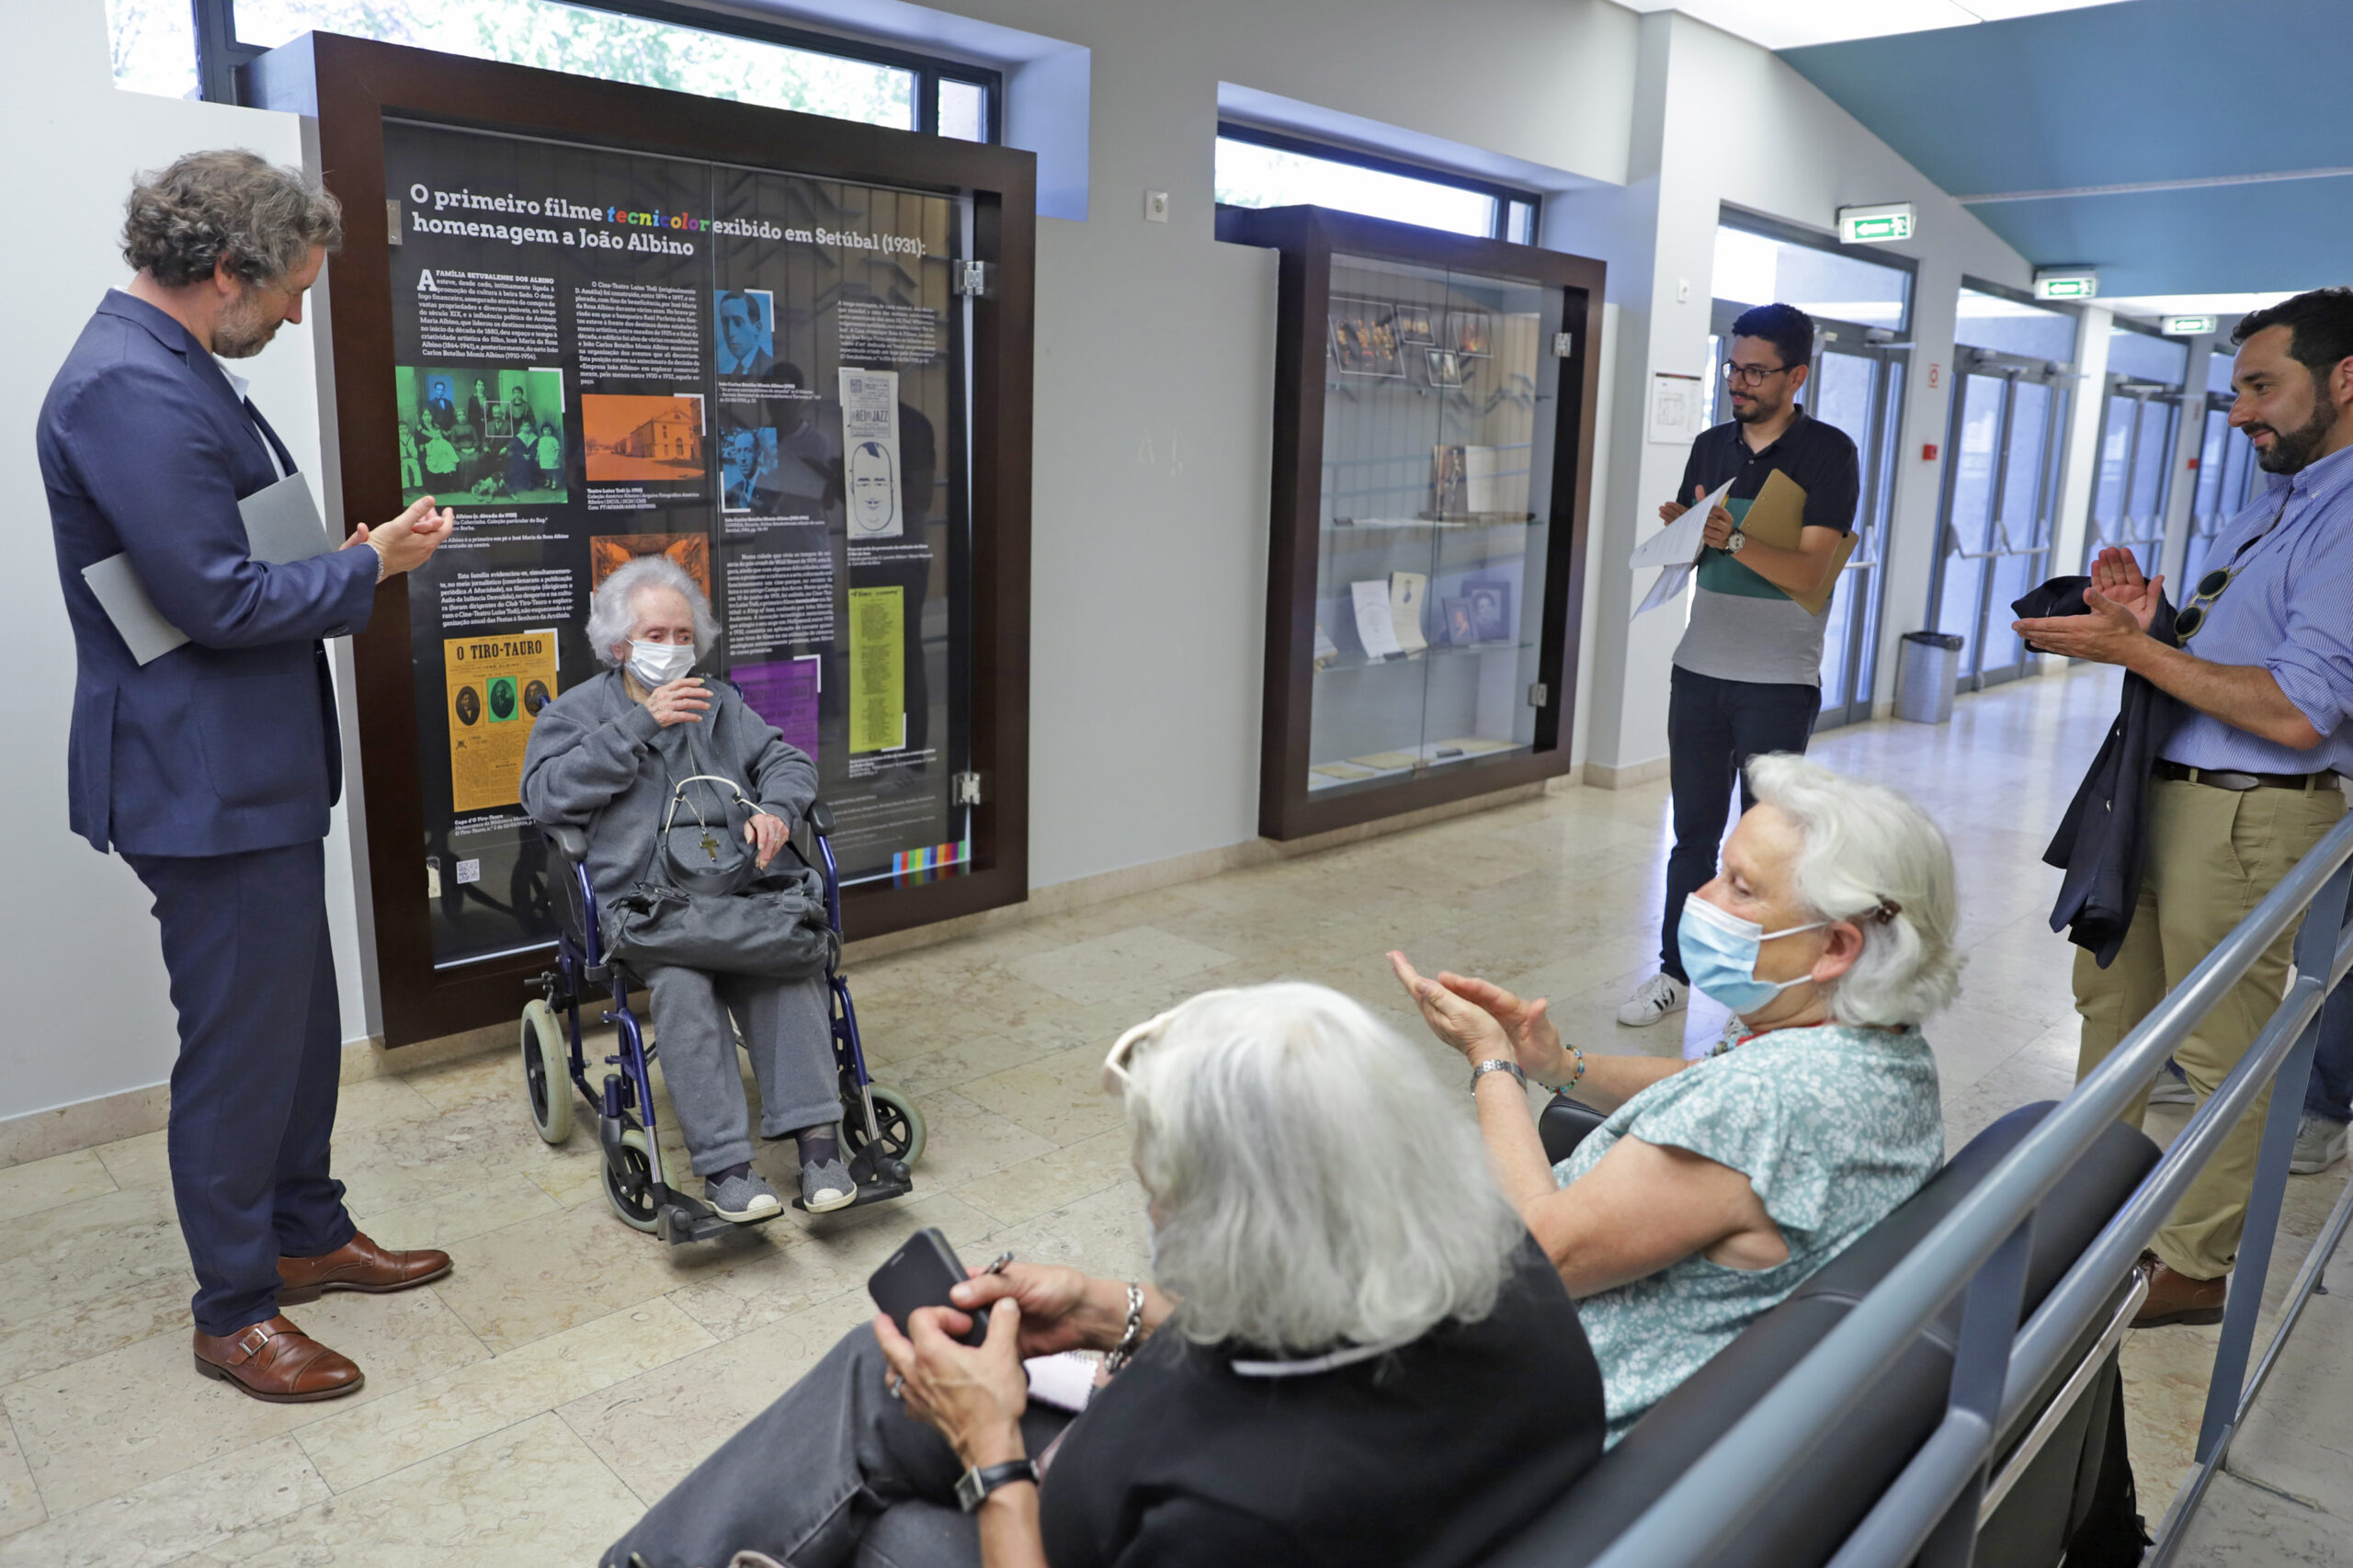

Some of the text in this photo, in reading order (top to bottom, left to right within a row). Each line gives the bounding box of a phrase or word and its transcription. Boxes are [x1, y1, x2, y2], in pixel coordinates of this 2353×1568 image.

[410, 184, 926, 257] O primeiro filme tecnicolor exibido em Setúbal (1931):
[412, 212, 694, 256] homenagem a João Albino
[417, 269, 437, 291] A
[436, 270, 465, 278] FAMÍLIA
[467, 273, 514, 281] SETUBALENSE
[872, 410, 888, 422] JAZZ
[457, 641, 542, 660] O TIRO-TAURO
